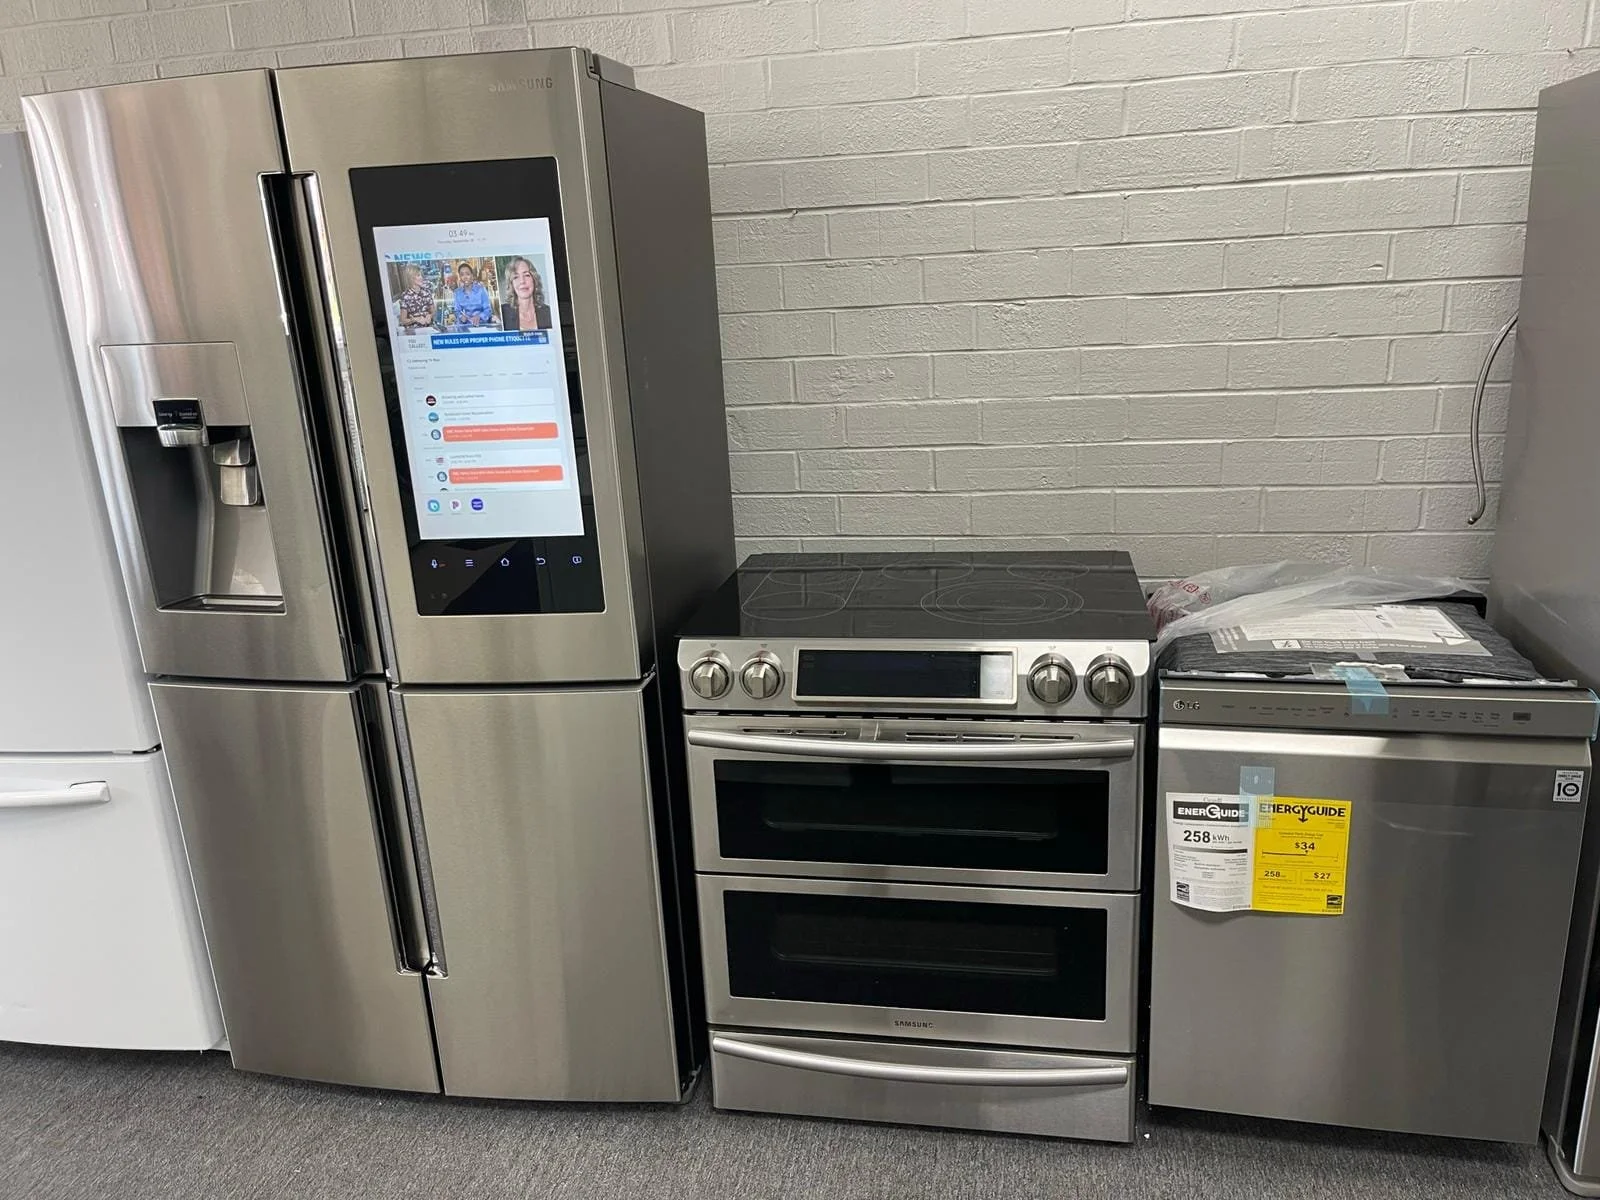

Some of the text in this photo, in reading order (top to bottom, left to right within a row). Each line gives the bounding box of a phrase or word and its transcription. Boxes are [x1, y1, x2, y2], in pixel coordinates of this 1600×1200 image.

[488, 77, 553, 92] SAMSUNG
[1187, 700, 1200, 711] LG
[1177, 804, 1246, 819] ENERGUIDE
[1260, 803, 1346, 824] ENERGYGUIDE
[1183, 829, 1211, 844] 258
[1212, 834, 1230, 842] kWh
[1294, 841, 1316, 851] $34
[1264, 870, 1281, 878] 258
[894, 1020, 935, 1029] SAMSUNG
